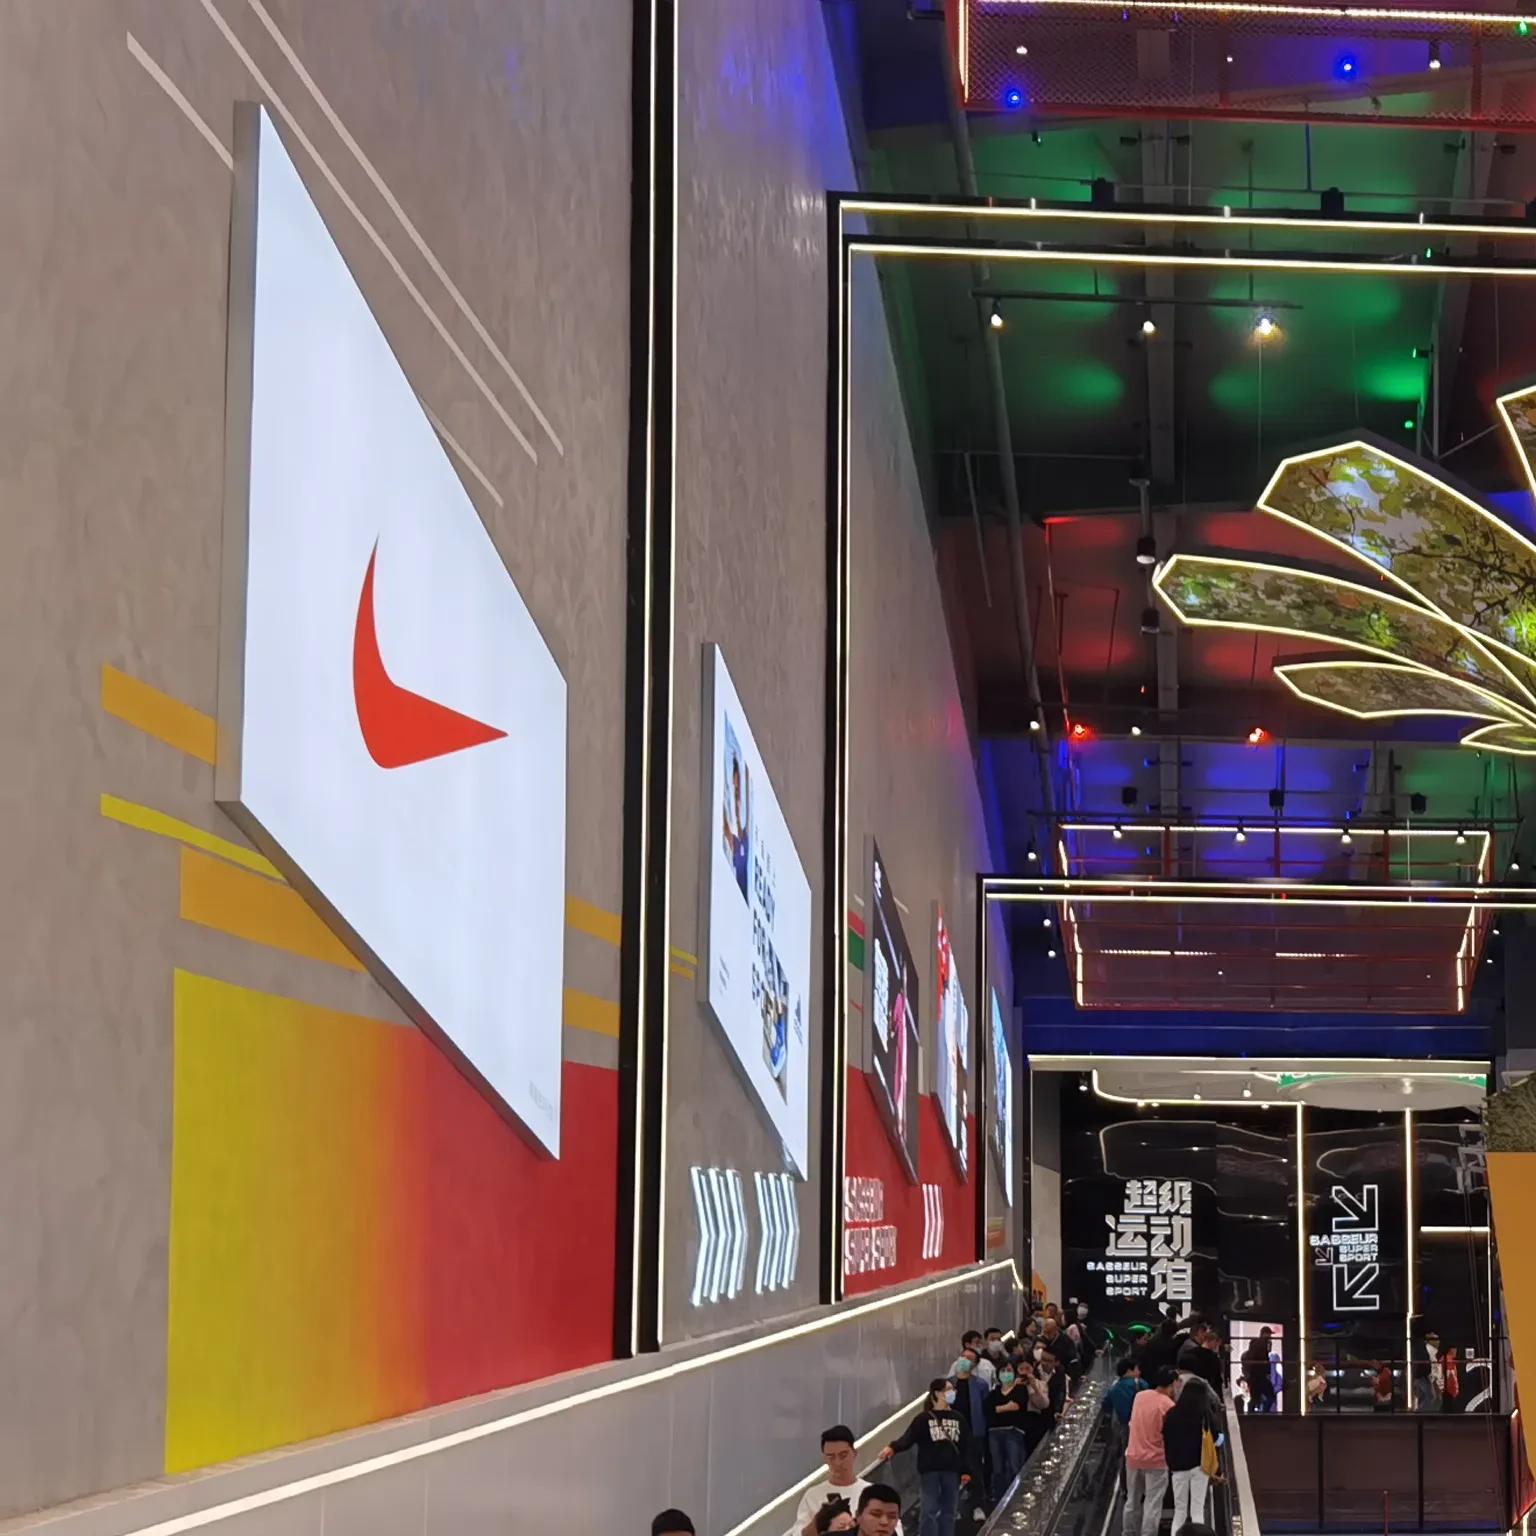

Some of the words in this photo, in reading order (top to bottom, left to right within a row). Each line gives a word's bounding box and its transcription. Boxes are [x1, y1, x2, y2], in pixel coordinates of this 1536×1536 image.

[1124, 1180, 1192, 1214] 超级
[1105, 1215, 1192, 1256] 运动
[1309, 1233, 1379, 1246] SASSEUR
[1338, 1245, 1379, 1254] SUPER
[1338, 1253, 1379, 1263] SPORT
[1086, 1261, 1148, 1272] SASSEUR
[1105, 1274, 1148, 1284] SUPER
[1151, 1258, 1192, 1300] 馆
[1105, 1286, 1148, 1296] SPORT
